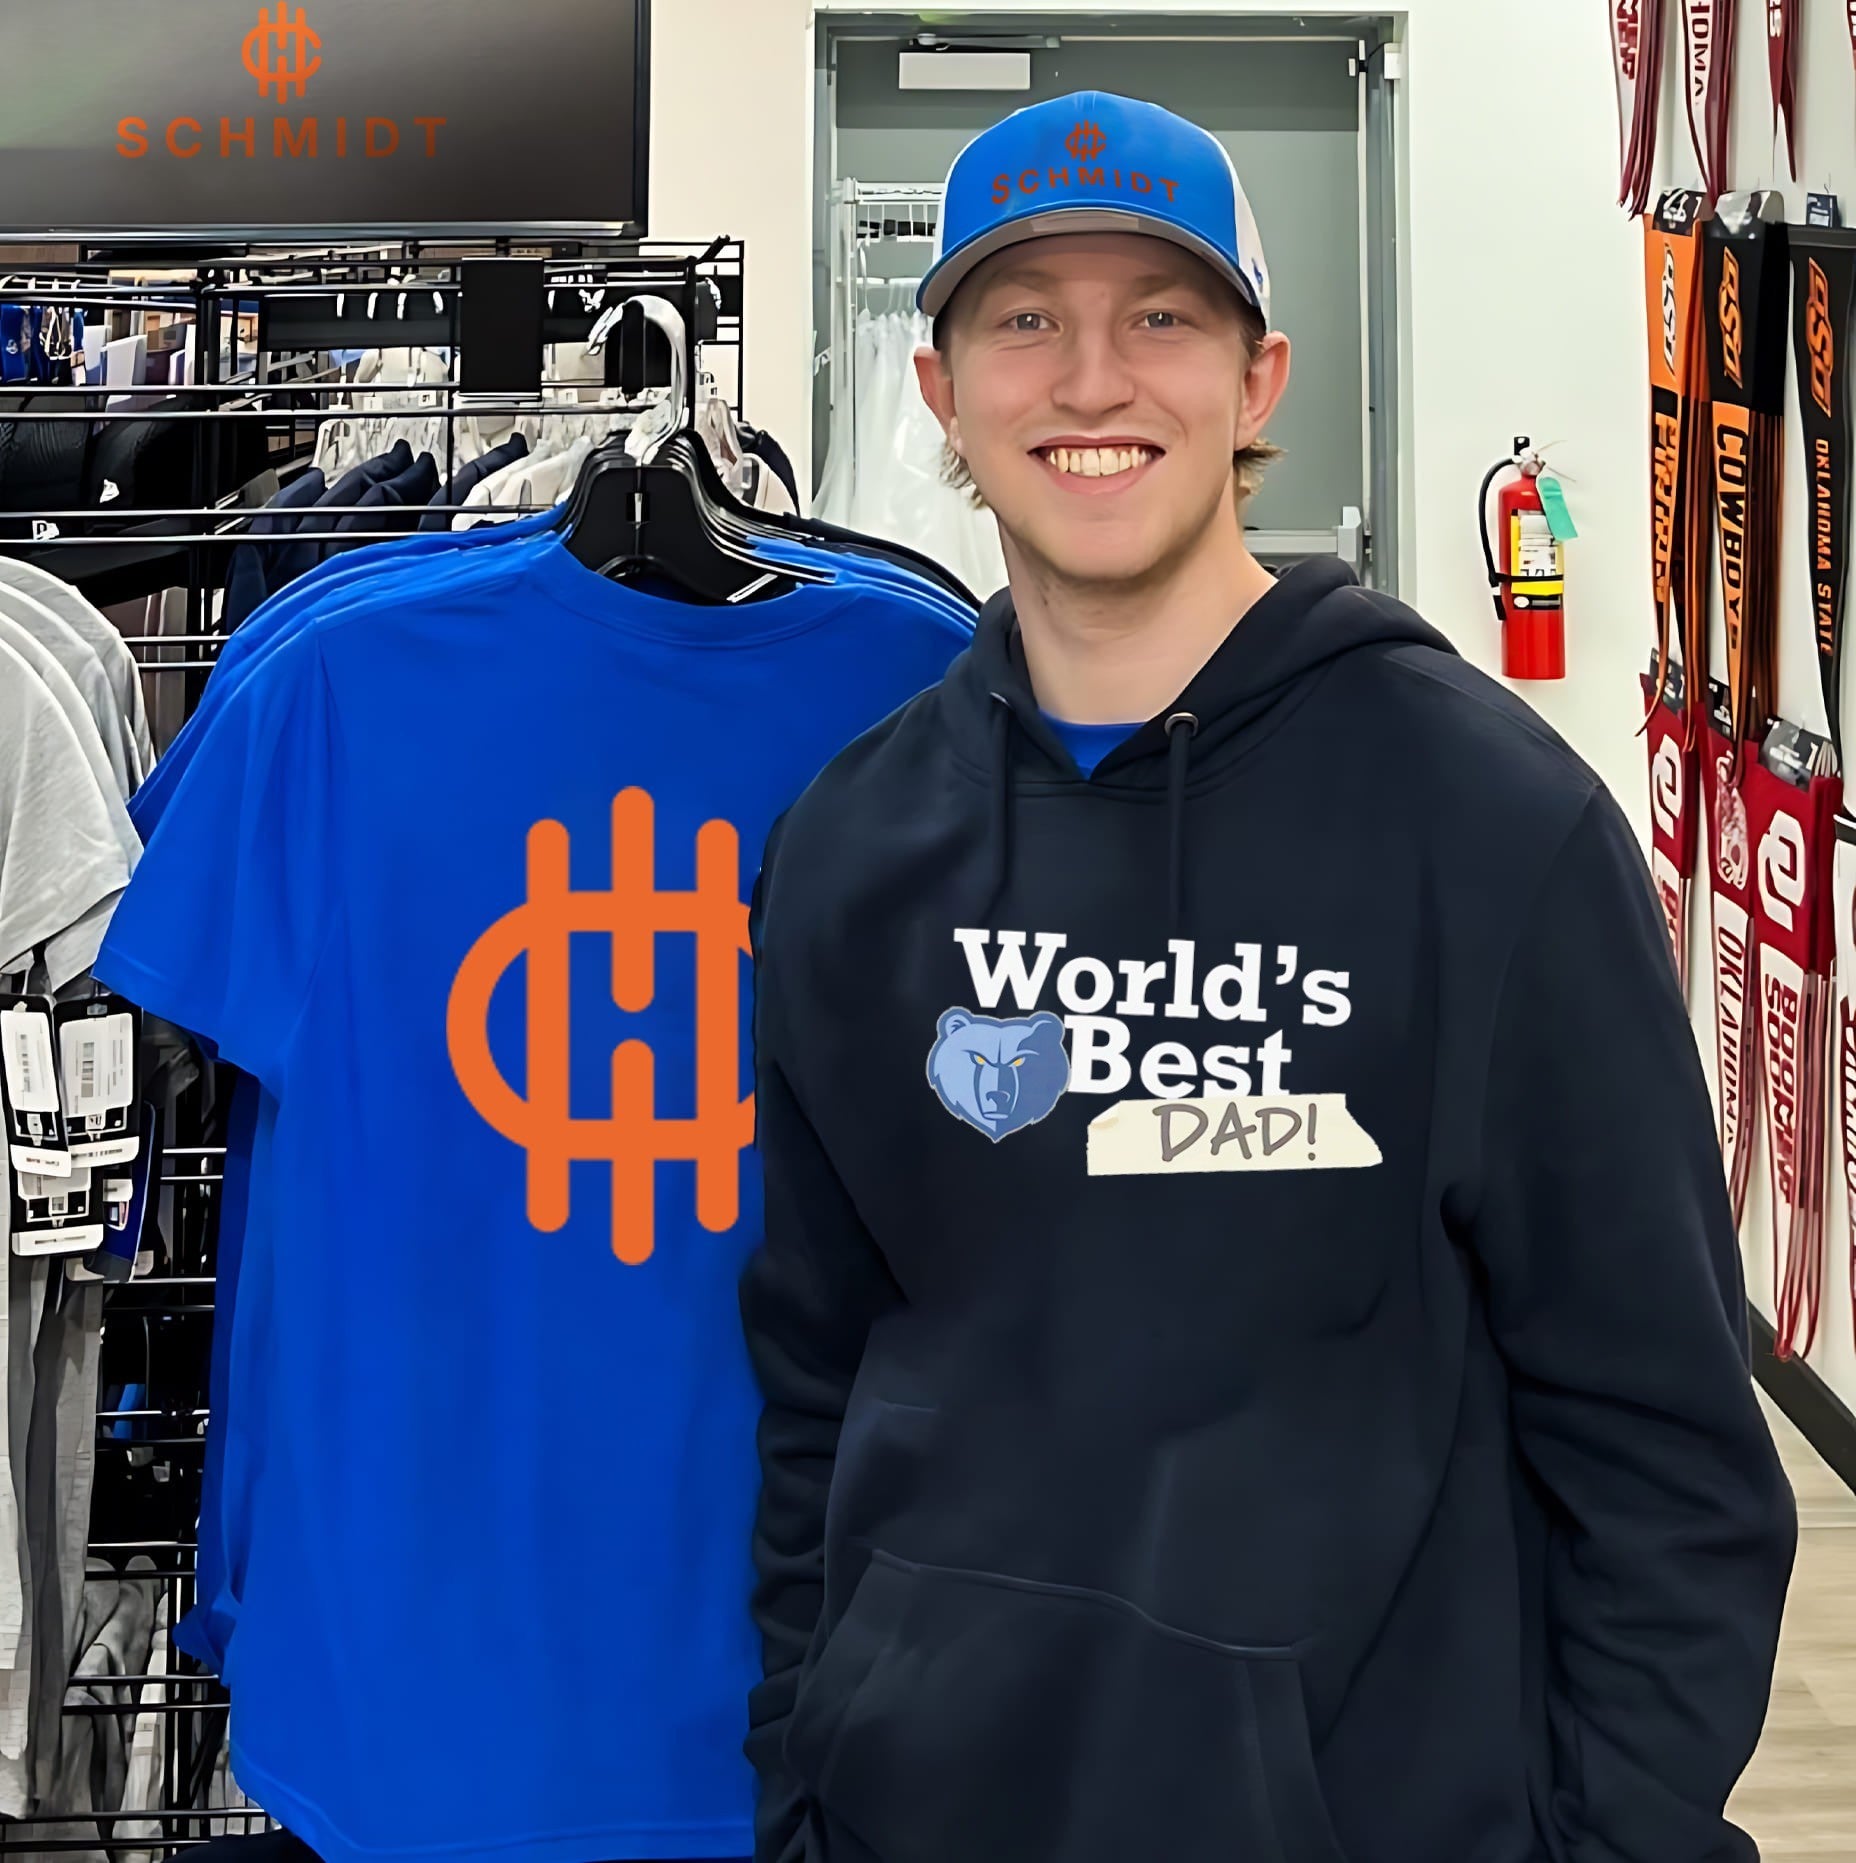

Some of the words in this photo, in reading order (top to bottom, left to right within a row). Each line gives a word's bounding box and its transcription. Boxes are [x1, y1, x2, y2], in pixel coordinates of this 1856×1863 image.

[115, 116, 448, 159] SCHMIDT
[991, 167, 1179, 204] SCHMIDT
[1815, 438, 1832, 571] OKLAHOMA
[953, 928, 1352, 1027] World's
[1064, 1014, 1292, 1099] Best
[1152, 1102, 1318, 1162] DAD!
